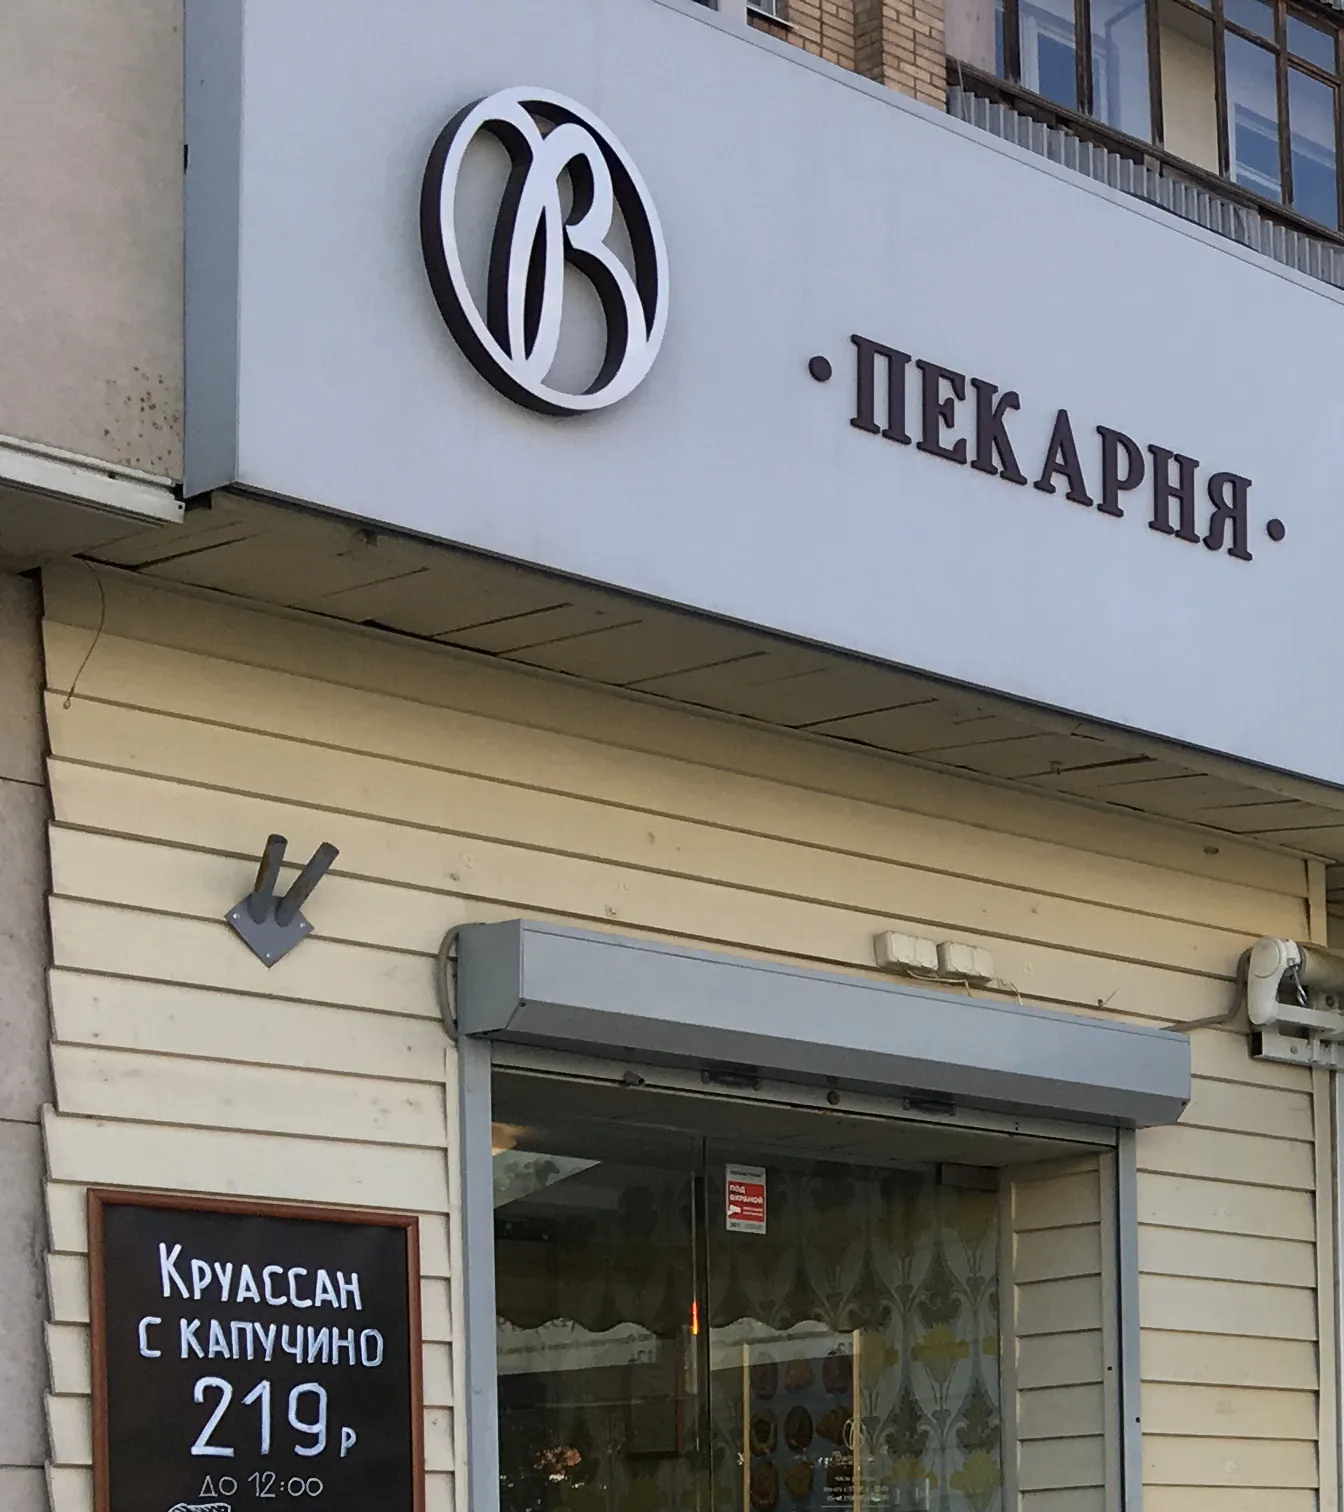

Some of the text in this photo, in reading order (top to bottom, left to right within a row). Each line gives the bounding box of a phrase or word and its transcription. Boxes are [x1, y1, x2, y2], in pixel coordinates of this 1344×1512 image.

[850, 334, 1253, 562] ПЕКАРНЯ
[180, 1318, 384, 1367] КАПУЧИНО
[248, 1471, 324, 1498] 12:00
